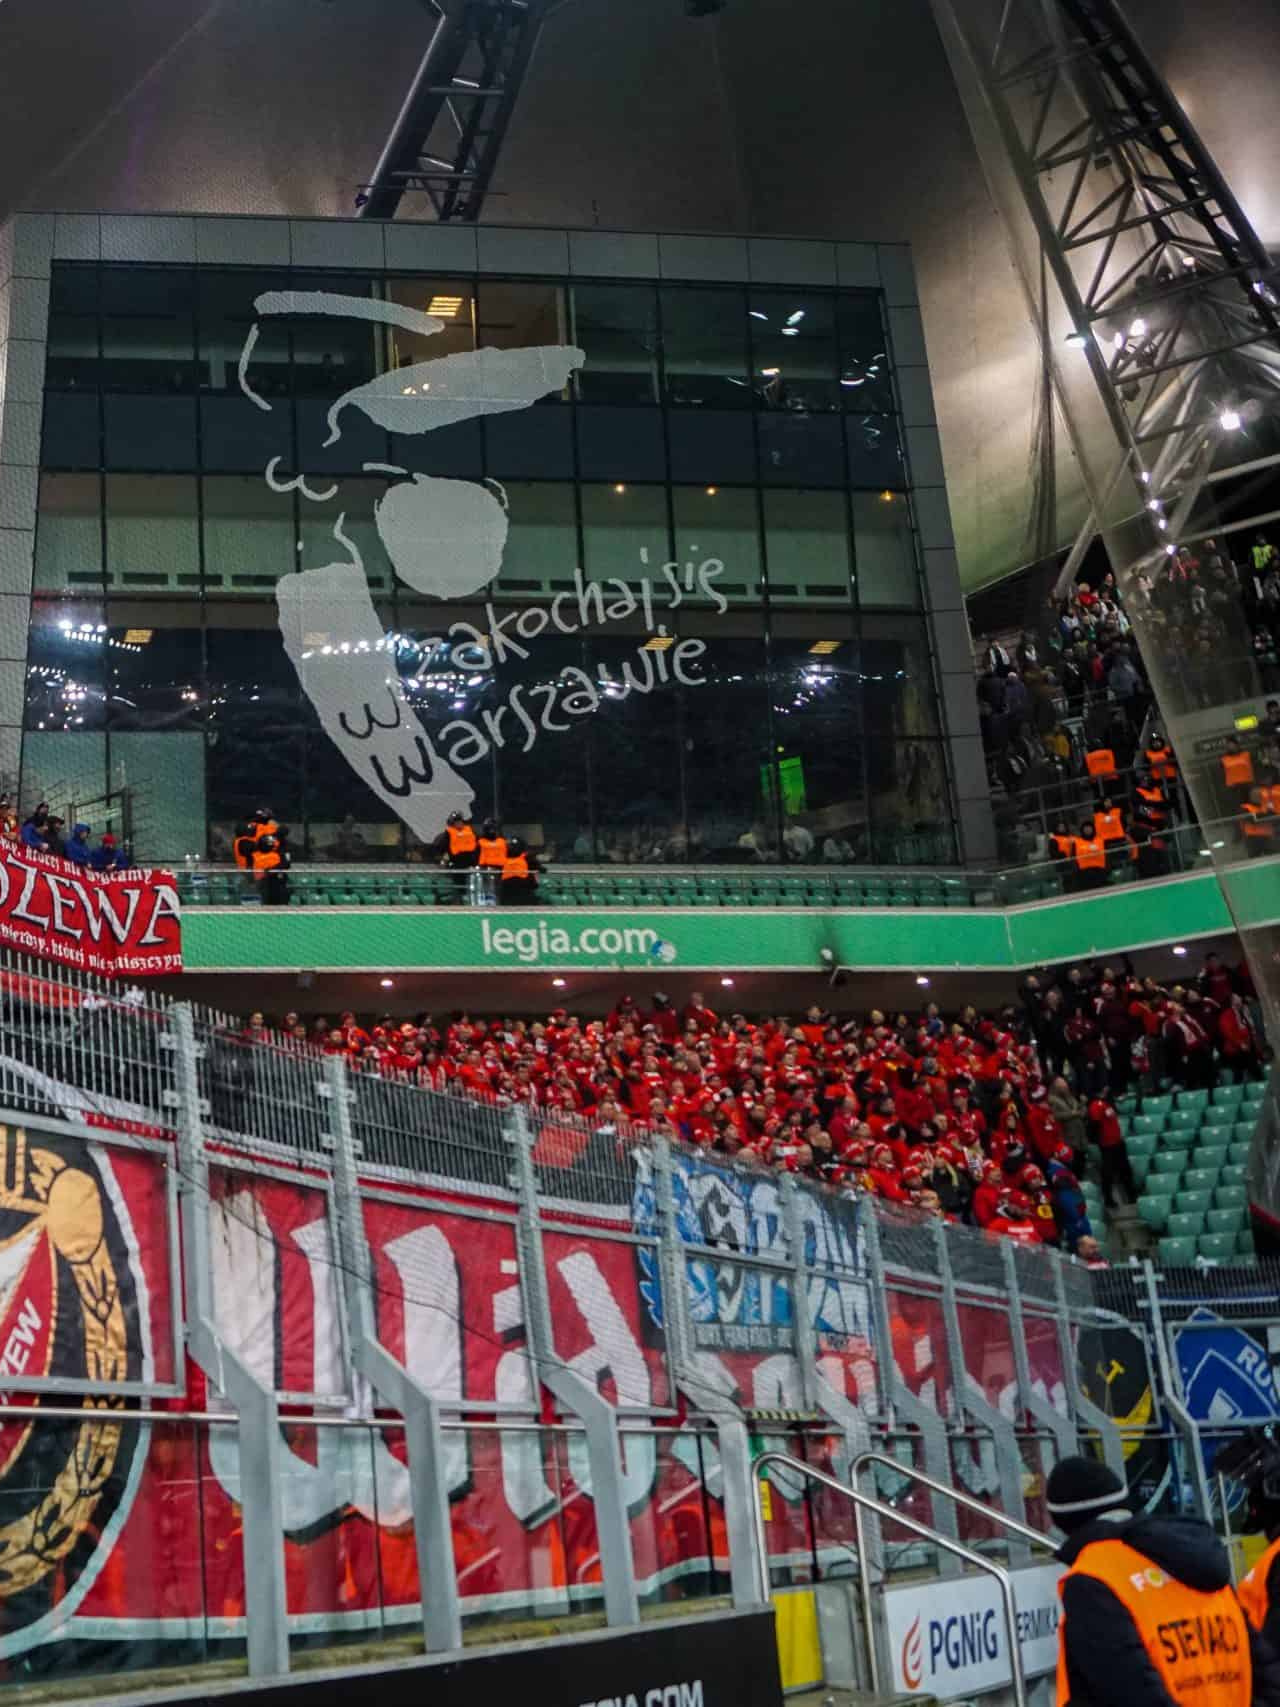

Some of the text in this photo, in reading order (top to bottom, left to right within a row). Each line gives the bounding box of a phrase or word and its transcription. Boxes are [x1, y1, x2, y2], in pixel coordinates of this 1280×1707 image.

[416, 545, 727, 677] zakochaj się
[481, 918, 658, 962] legia.com
[928, 1608, 998, 1676] PGNiG
